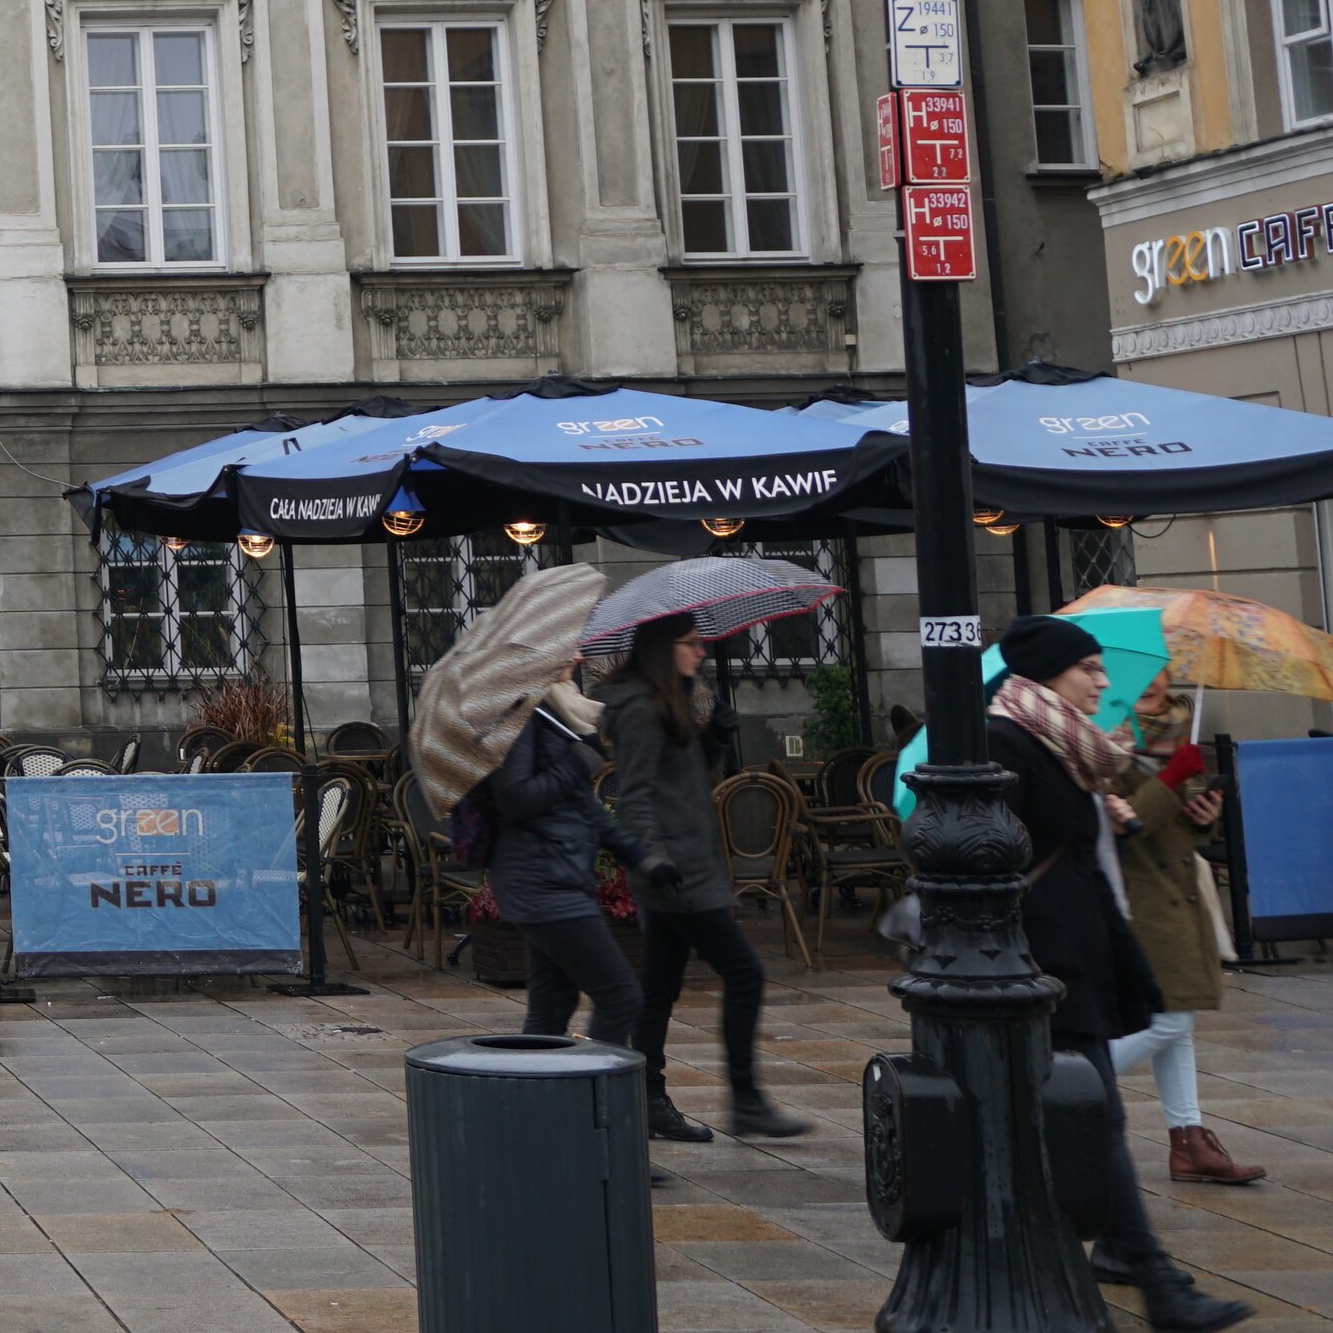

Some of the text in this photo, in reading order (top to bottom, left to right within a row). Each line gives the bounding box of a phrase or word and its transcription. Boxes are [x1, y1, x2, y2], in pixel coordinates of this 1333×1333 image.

[896, 6, 916, 32] Z
[918, 2, 953, 16] 19441
[934, 23, 954, 38] 150
[908, 101, 927, 127] H
[926, 97, 960, 112] 33941
[942, 118, 963, 134] 150
[910, 197, 931, 224] H
[929, 193, 966, 208] 33942
[946, 214, 968, 230] 150
[1132, 226, 1236, 305] green
[556, 416, 664, 435] green
[1039, 412, 1151, 434] green
[1061, 441, 1193, 457] NERO
[715, 478, 743, 501] W
[270, 497, 296, 520] CAŁA
[298, 497, 343, 520] NADZIEJA
[346, 496, 357, 518] W
[96, 809, 204, 844] green
[90, 880, 216, 909] NERO
